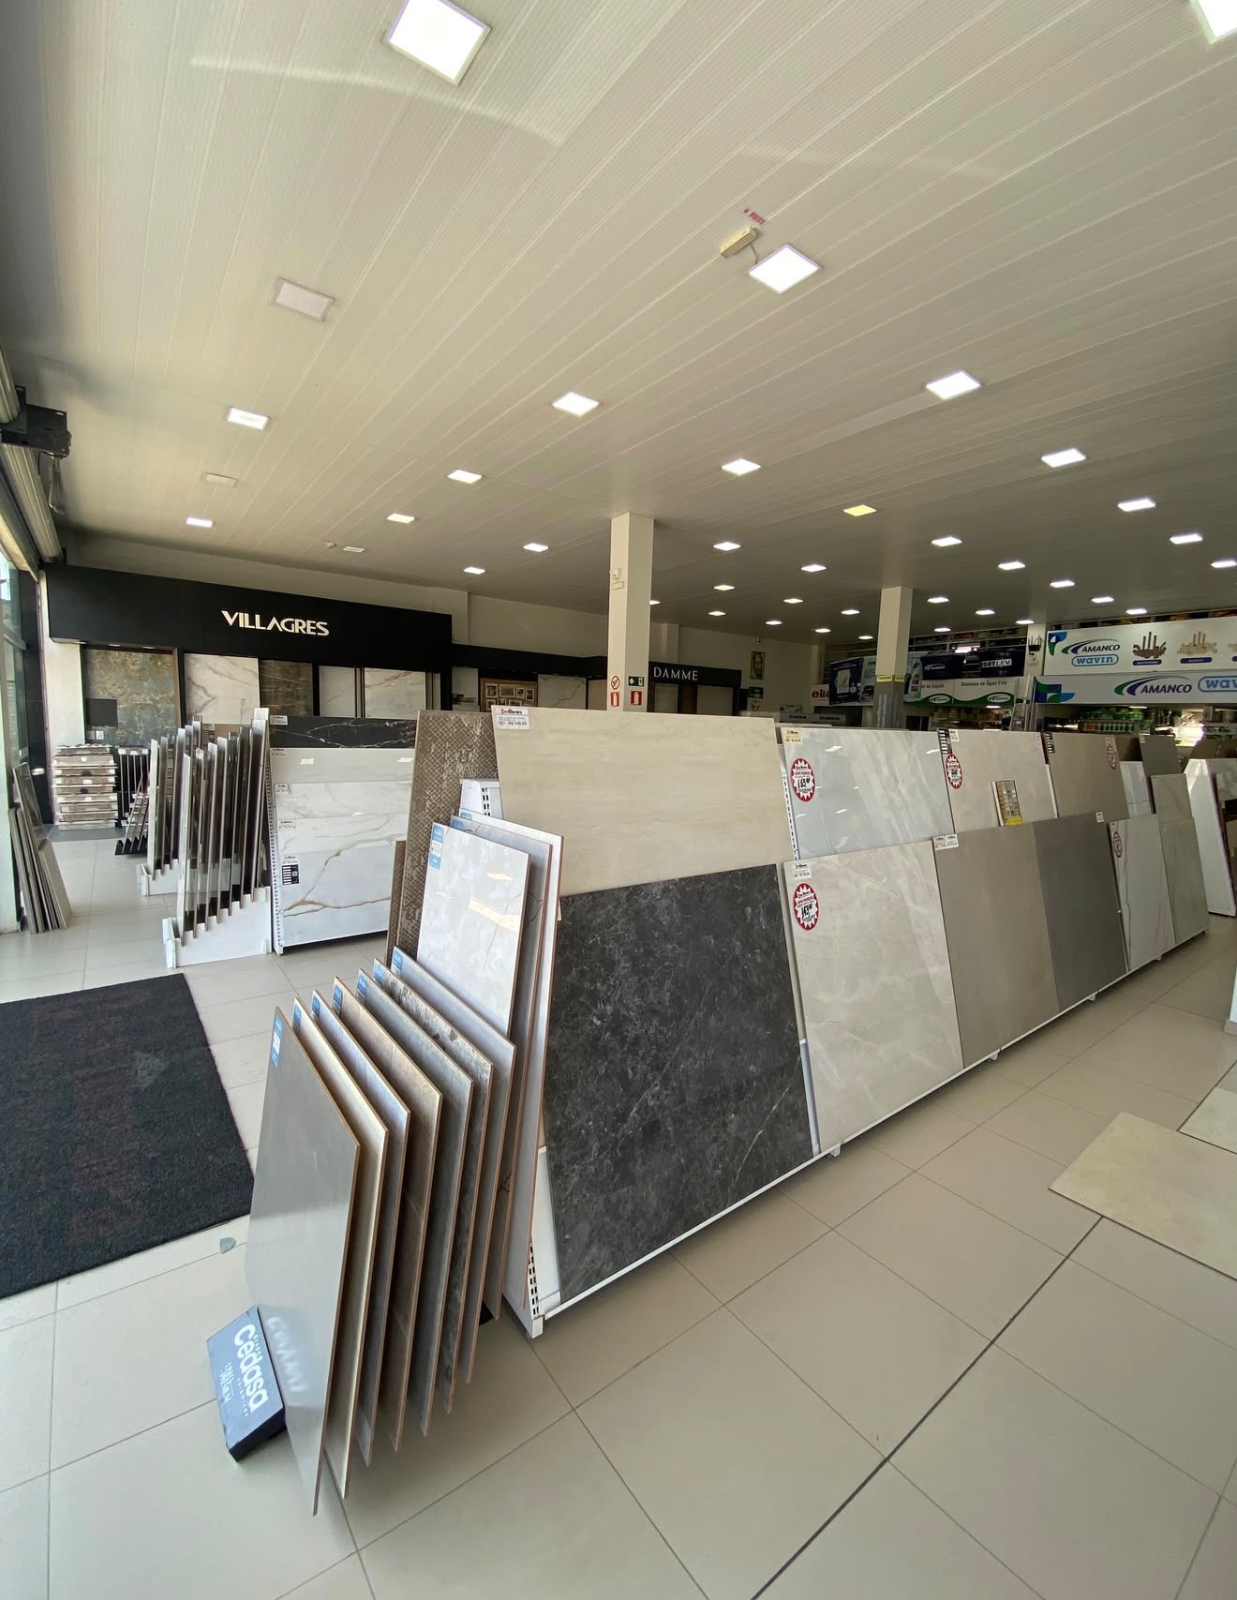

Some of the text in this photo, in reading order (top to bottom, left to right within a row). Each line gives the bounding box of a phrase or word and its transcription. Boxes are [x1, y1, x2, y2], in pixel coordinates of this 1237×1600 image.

[221, 610, 330, 637] VILLAGRES
[1081, 644, 1121, 654] AMANCO
[1076, 655, 1114, 665] wavin
[653, 666, 699, 682] DAMME
[1141, 683, 1193, 695] AMANCO
